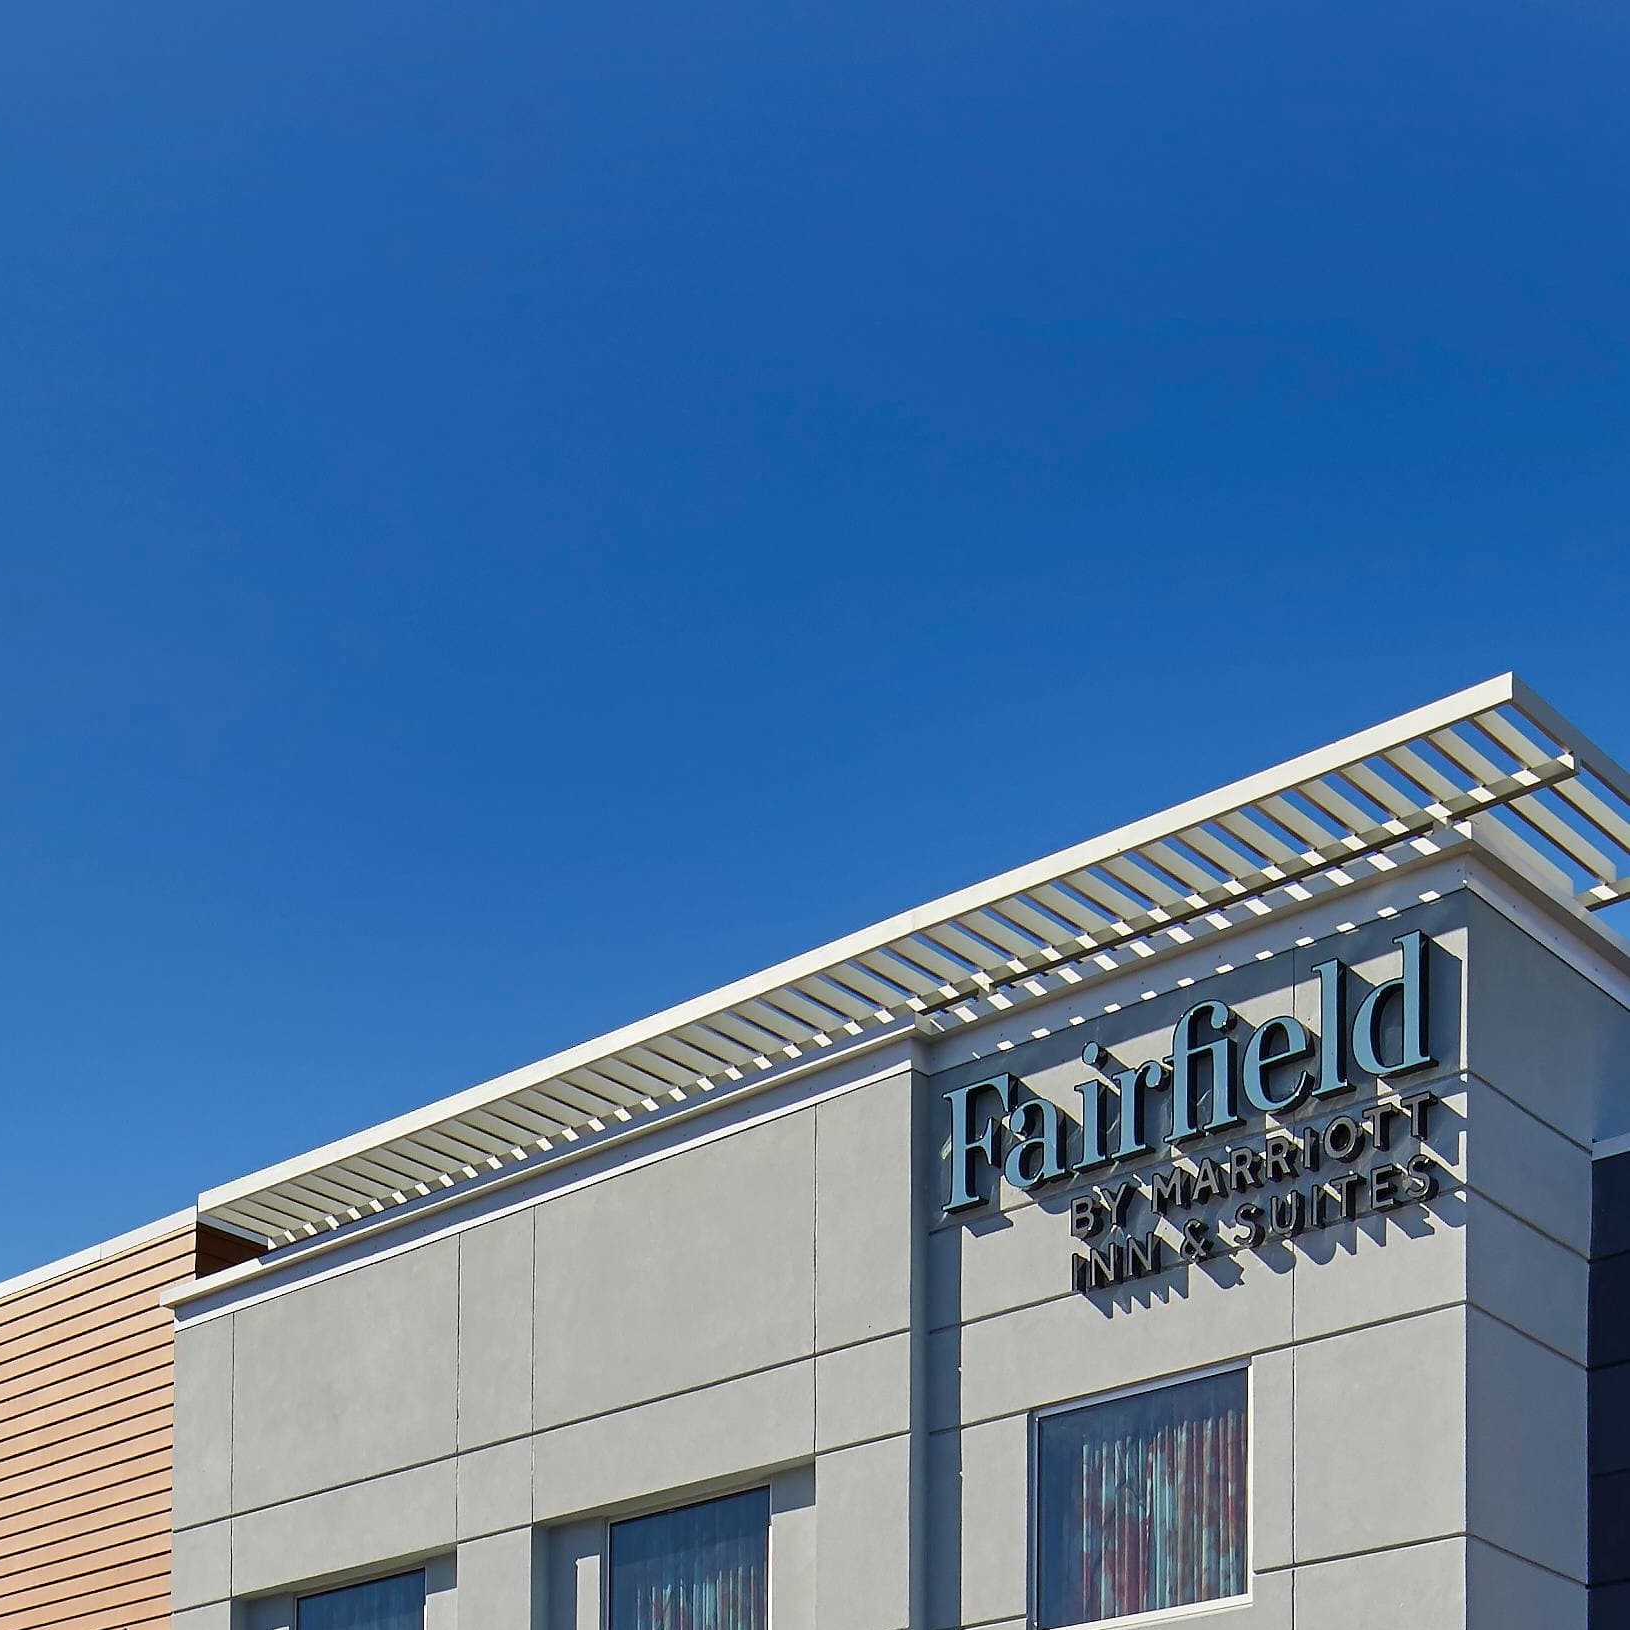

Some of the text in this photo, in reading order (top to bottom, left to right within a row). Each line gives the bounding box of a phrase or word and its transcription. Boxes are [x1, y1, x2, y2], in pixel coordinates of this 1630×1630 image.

[941, 928, 1440, 1214] Fairfield
[1070, 1091, 1436, 1239] BY MARRIOTT
[1071, 1154, 1439, 1294] INN & SUITES
